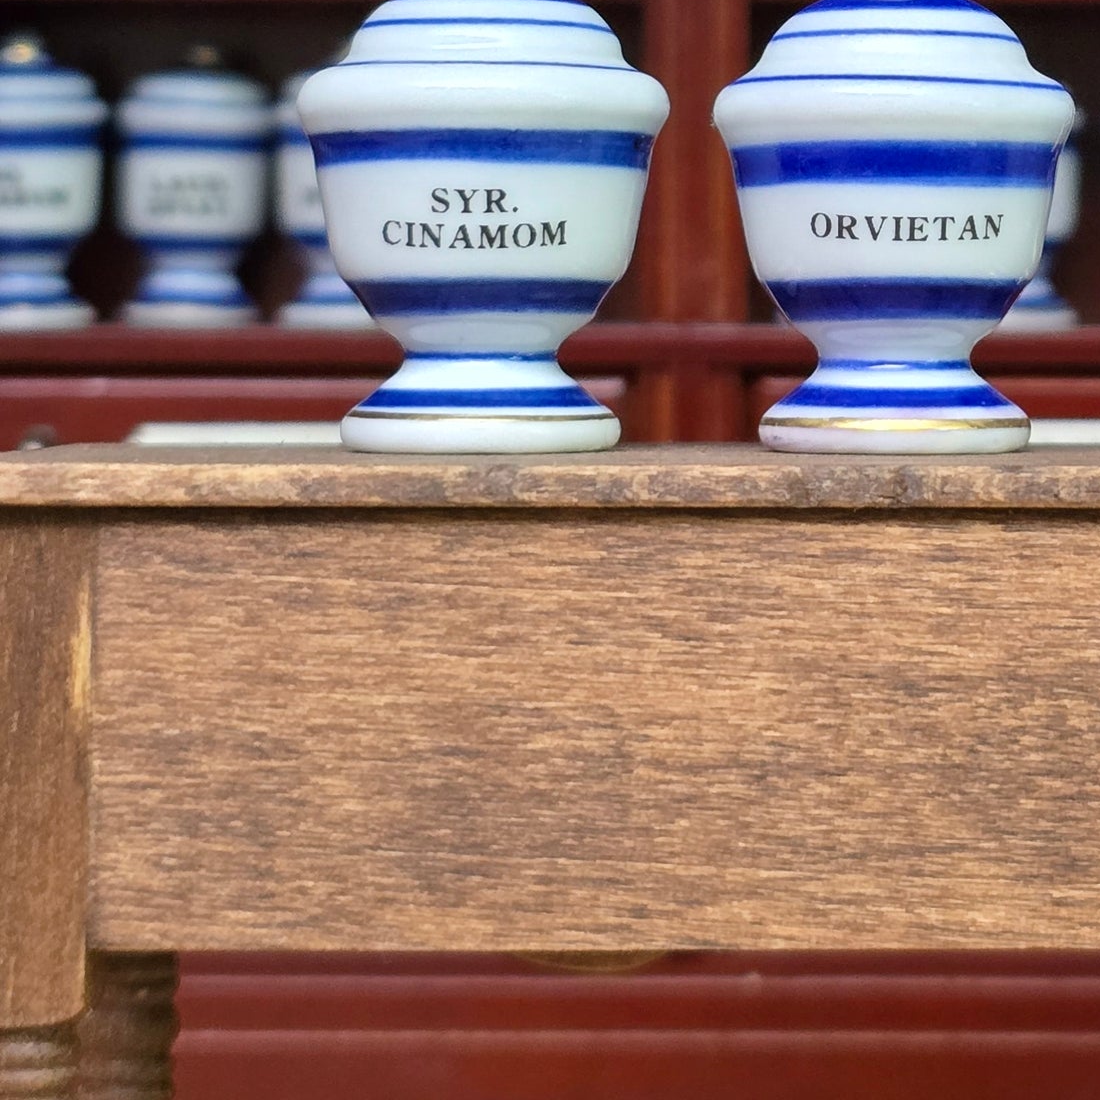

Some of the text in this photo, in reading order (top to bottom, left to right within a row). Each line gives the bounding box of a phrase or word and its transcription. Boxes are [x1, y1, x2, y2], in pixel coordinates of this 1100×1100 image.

[431, 188, 518, 214] SYR.
[382, 220, 567, 249] CINAMOM
[810, 212, 1004, 242] ORVIETAN
